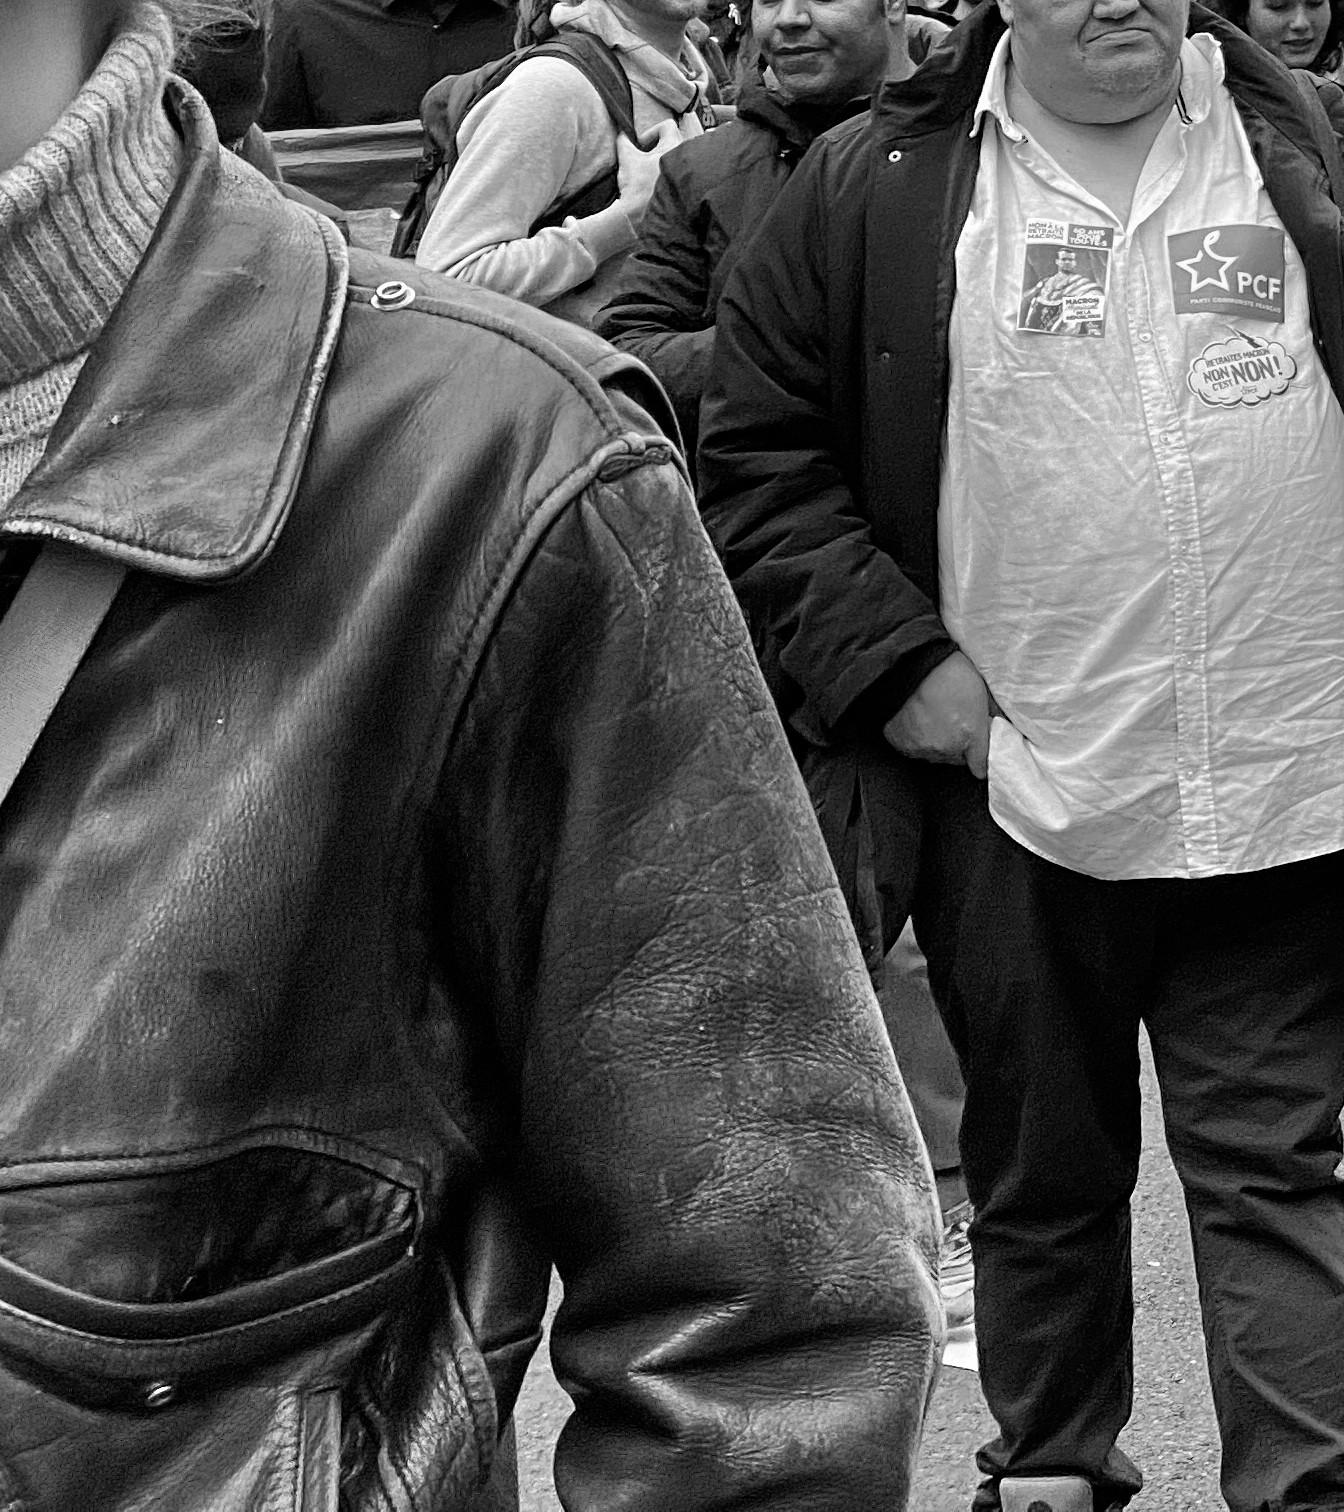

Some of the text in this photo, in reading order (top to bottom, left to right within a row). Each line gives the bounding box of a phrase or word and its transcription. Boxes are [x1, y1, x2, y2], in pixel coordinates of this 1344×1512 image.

[1237, 271, 1281, 300] PCF
[1205, 352, 1243, 367] RETRAITES
[1203, 366, 1230, 383] NON
